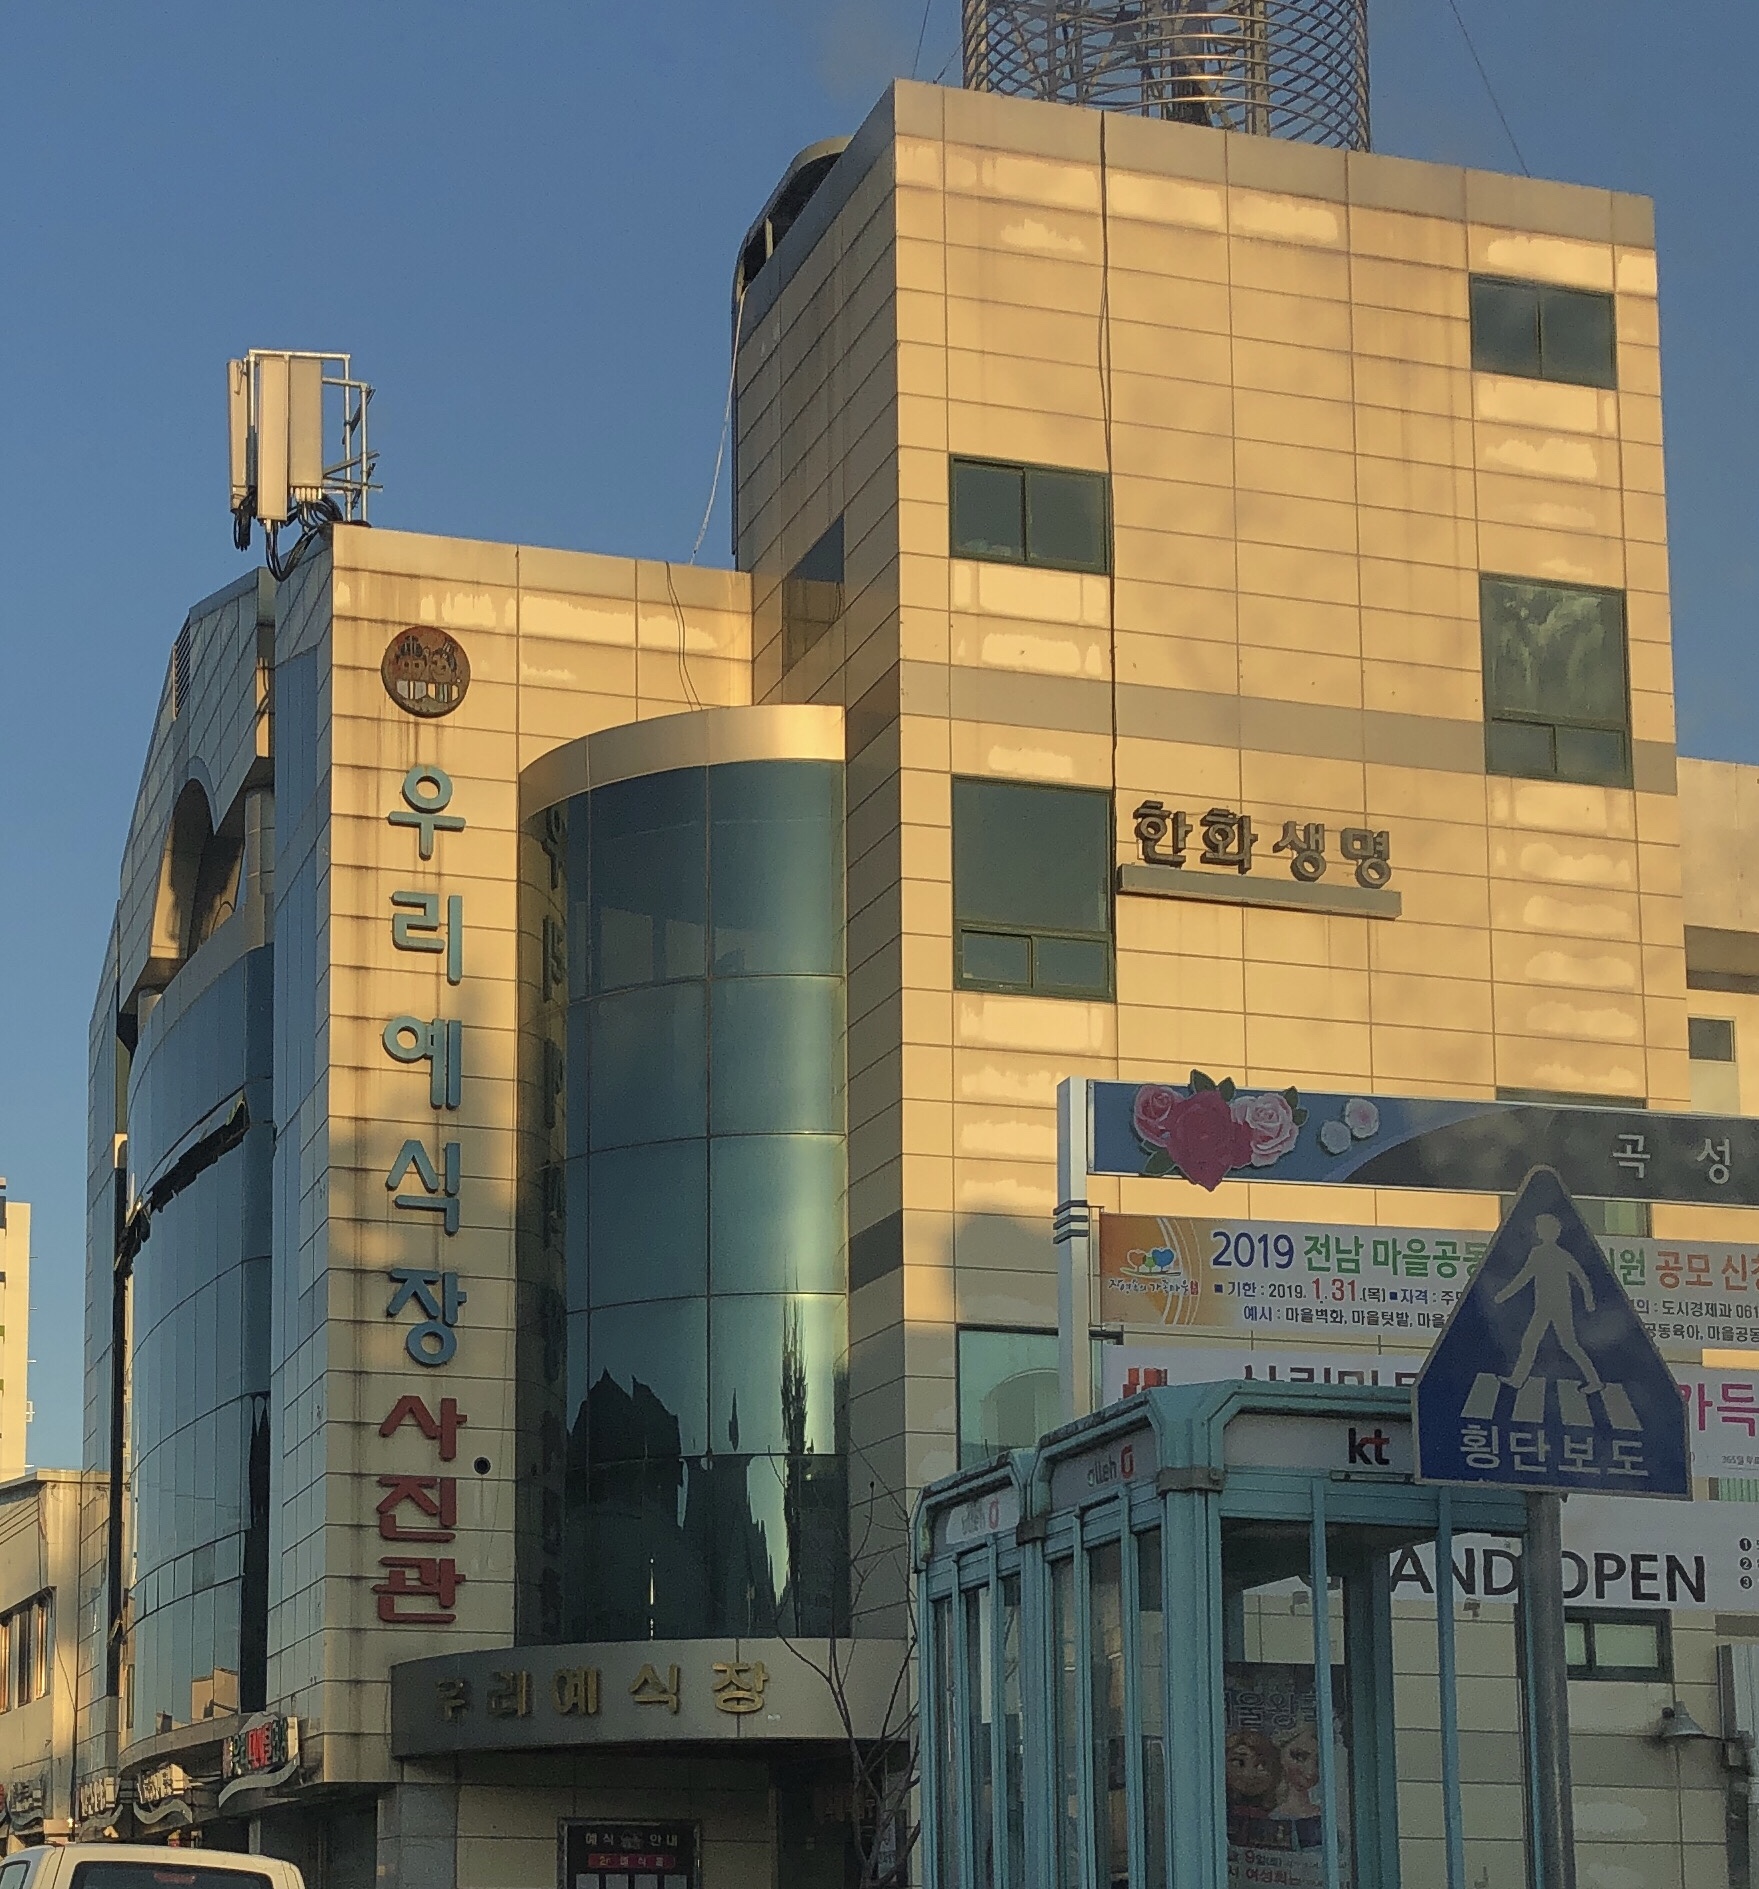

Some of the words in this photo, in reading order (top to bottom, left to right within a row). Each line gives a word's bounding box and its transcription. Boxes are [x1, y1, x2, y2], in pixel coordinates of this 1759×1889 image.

[1133, 800, 1391, 889] 한화생명
[381, 766, 467, 1366] 우리예식장
[1212, 1231, 1295, 1269] 2019
[1303, 1233, 1364, 1274] 전남
[1655, 1250, 1714, 1289] 공모
[1227, 1281, 1259, 1298] 기한
[1400, 1288, 1428, 1304] 자격
[1631, 1300, 1650, 1314] 의
[1662, 1301, 1732, 1318] 도시경제과
[1243, 1305, 1273, 1321] 예시
[1286, 1306, 1348, 1325] 마을벽화,
[1352, 1310, 1413, 1328] 마을텃밭,
[1348, 1428, 1391, 1465] kt
[1460, 1425, 1648, 1476] 횡단보도
[1087, 1455, 1118, 1488] olleh
[371, 1395, 467, 1623] 사진관
[649, 1833, 678, 1848] 안내
